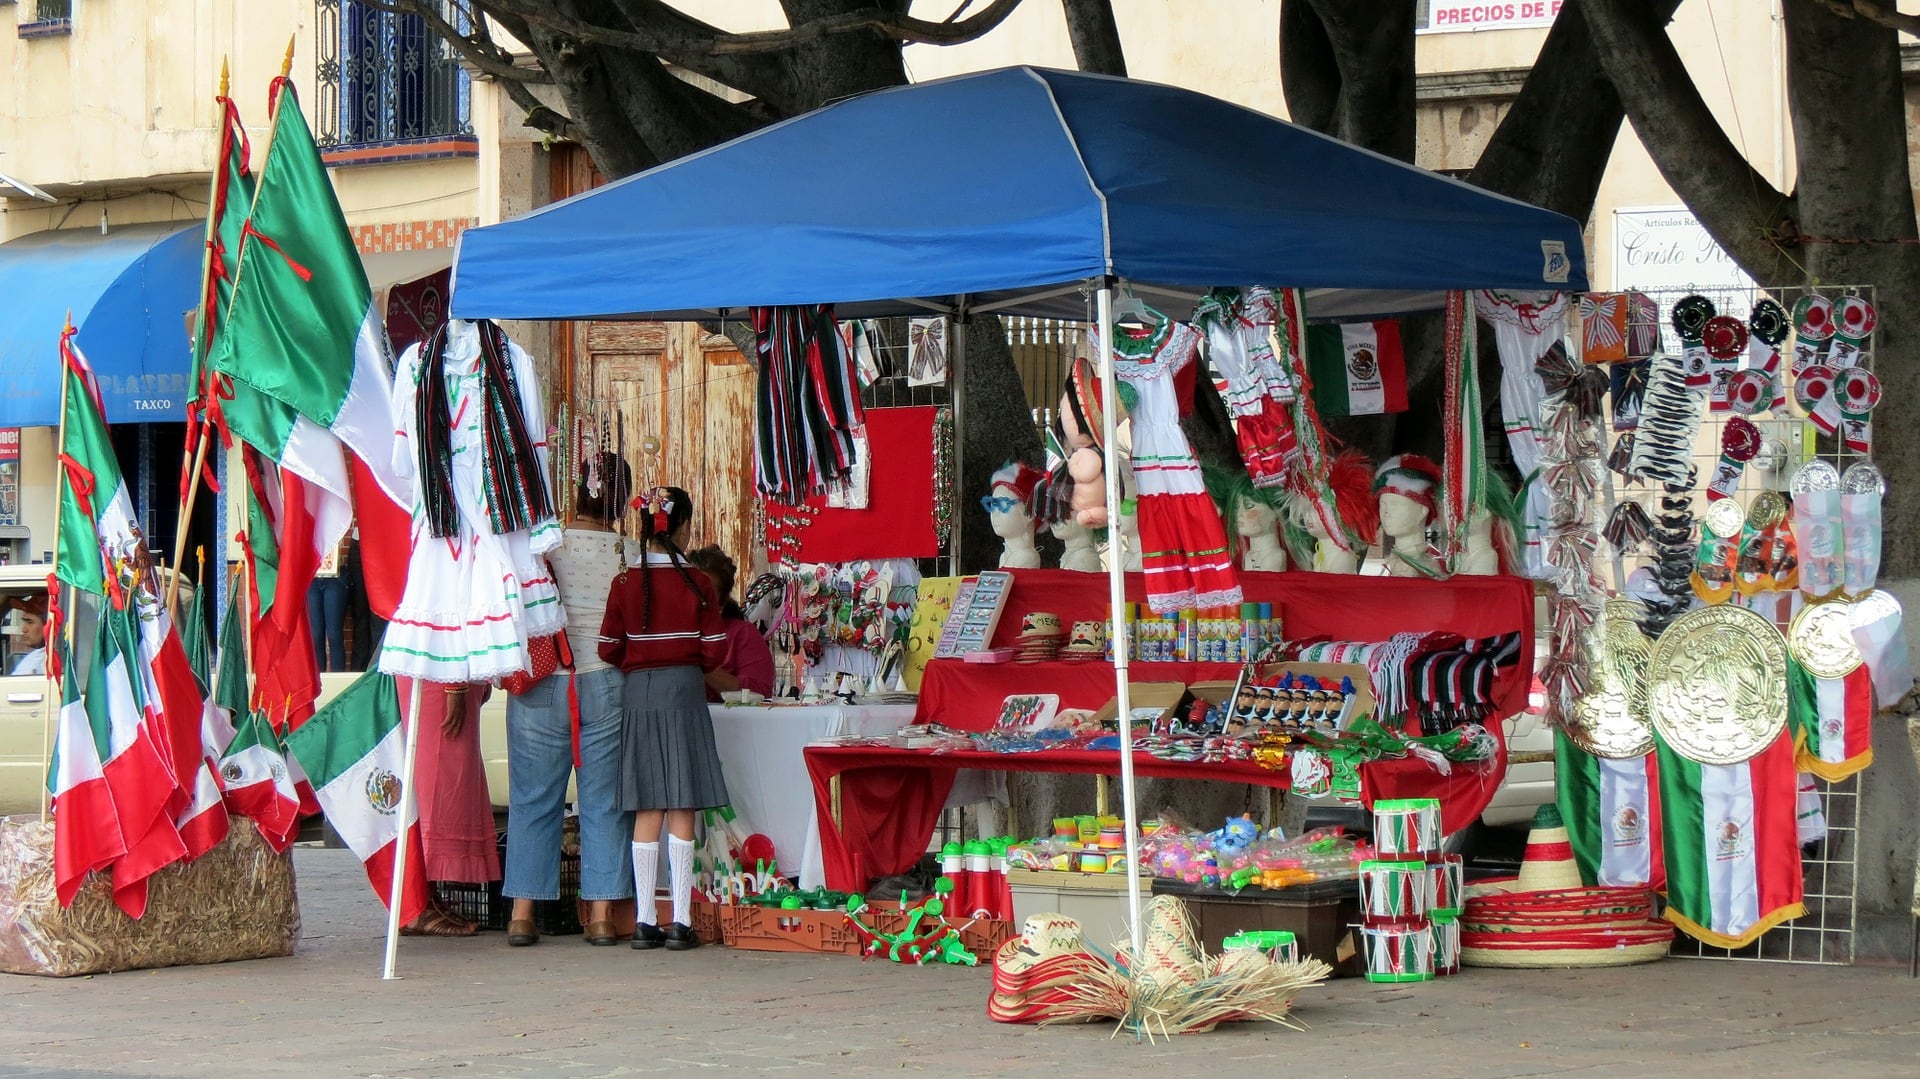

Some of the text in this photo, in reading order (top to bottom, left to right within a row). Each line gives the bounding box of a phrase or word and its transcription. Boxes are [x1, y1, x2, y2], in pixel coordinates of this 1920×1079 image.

[1437, 4, 1515, 24] PRECIOS
[1521, 2, 1545, 18] DE
[1644, 218, 1682, 228] Artículos
[1622, 231, 1686, 266] Cristo
[133, 399, 171, 410] TAXCO
